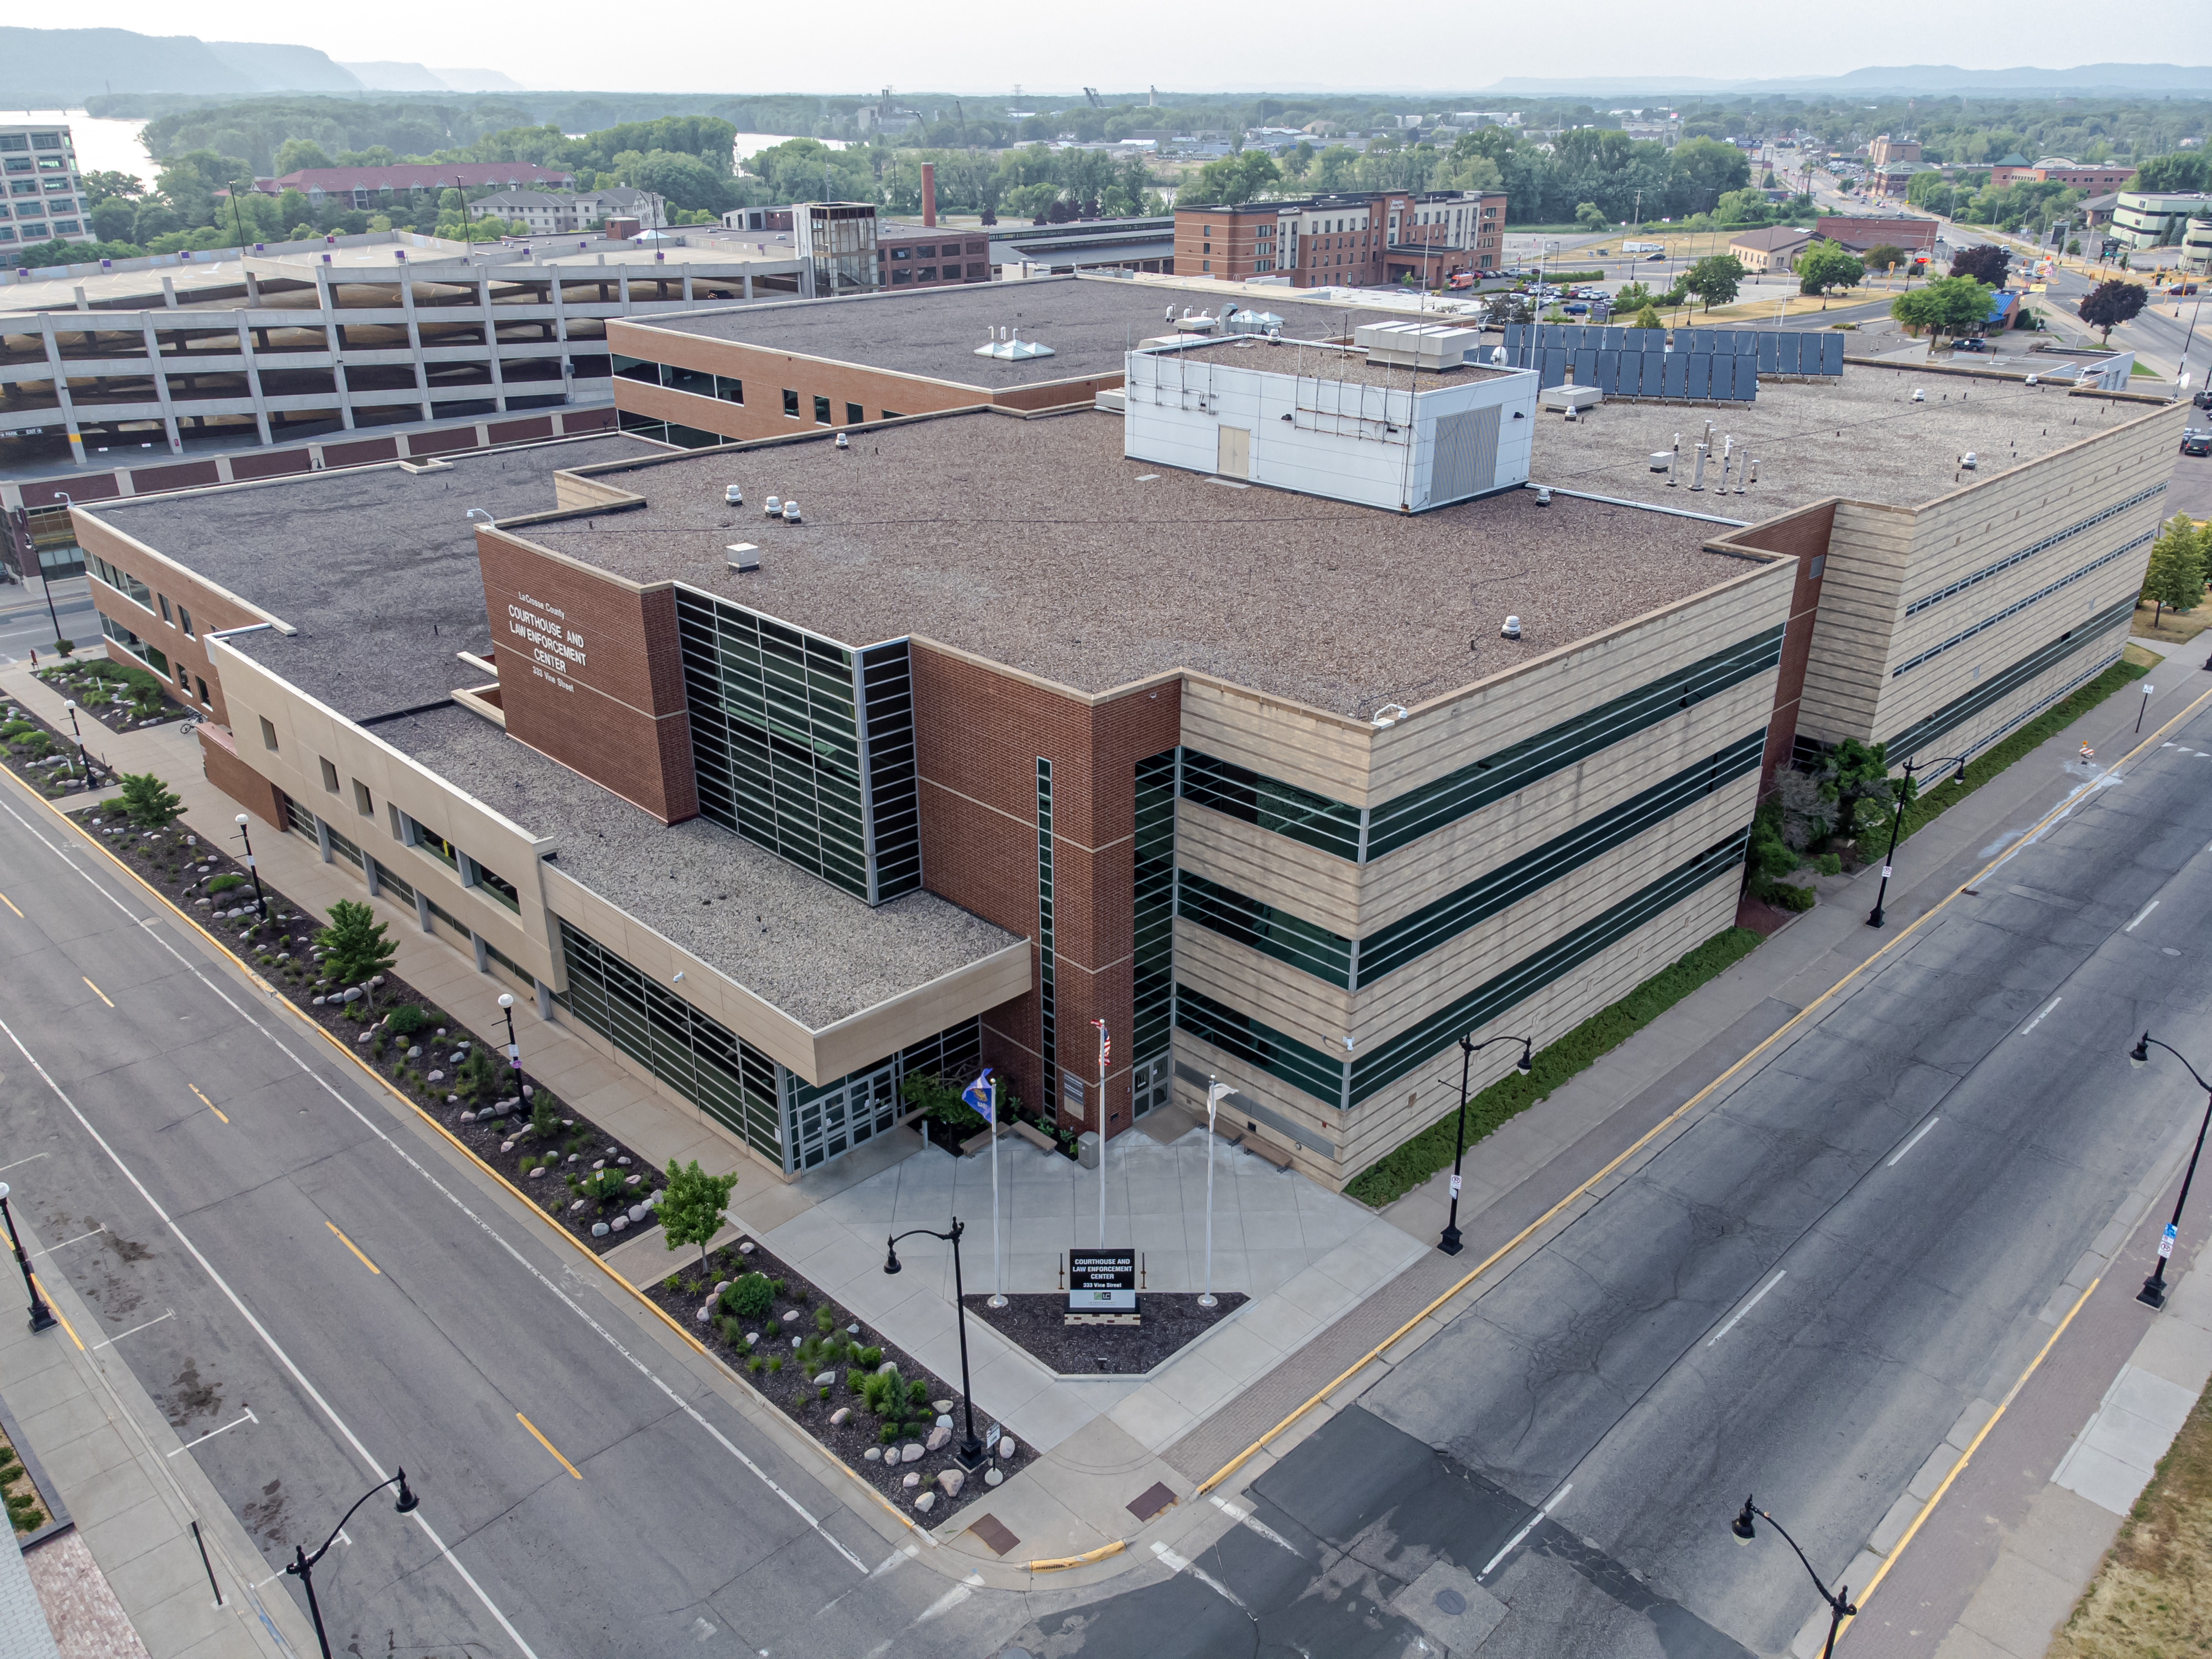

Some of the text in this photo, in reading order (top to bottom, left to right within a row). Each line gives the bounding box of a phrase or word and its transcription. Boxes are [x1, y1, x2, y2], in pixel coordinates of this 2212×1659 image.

[545, 603, 565, 620] County
[509, 604, 584, 648] COURTHOUSE AND
[509, 620, 586, 666] LAW ENFORCEMENT
[534, 648, 566, 673] CENTER
[533, 666, 575, 693] 333 Vine Street
